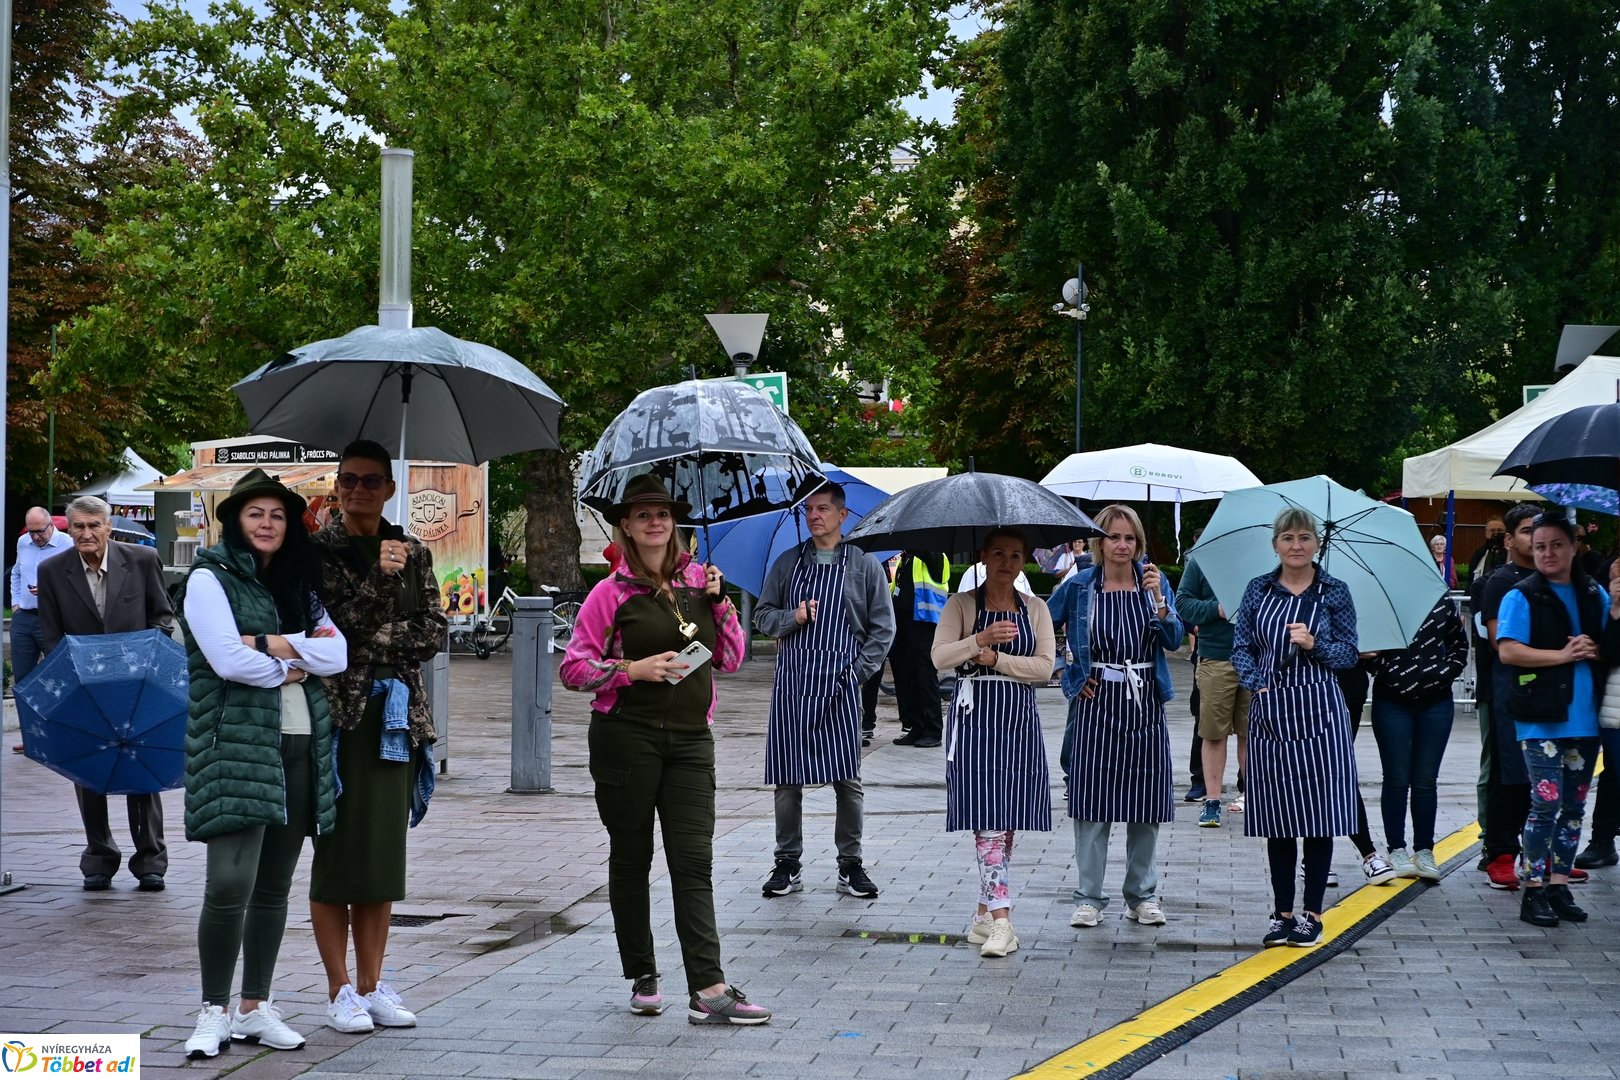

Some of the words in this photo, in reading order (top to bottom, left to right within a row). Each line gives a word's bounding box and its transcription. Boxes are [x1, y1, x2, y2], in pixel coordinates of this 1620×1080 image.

[230, 452, 256, 460] SZABOLCSI
[257, 450, 268, 460] HÁZI
[269, 450, 291, 459] PÁLINKA
[306, 449, 325, 459] FRÖCCS
[1149, 471, 1182, 479] BOROVI
[411, 493, 447, 506] SZABOLCSI
[408, 522, 423, 537] HÁZI
[423, 523, 450, 538] PÁLINKA
